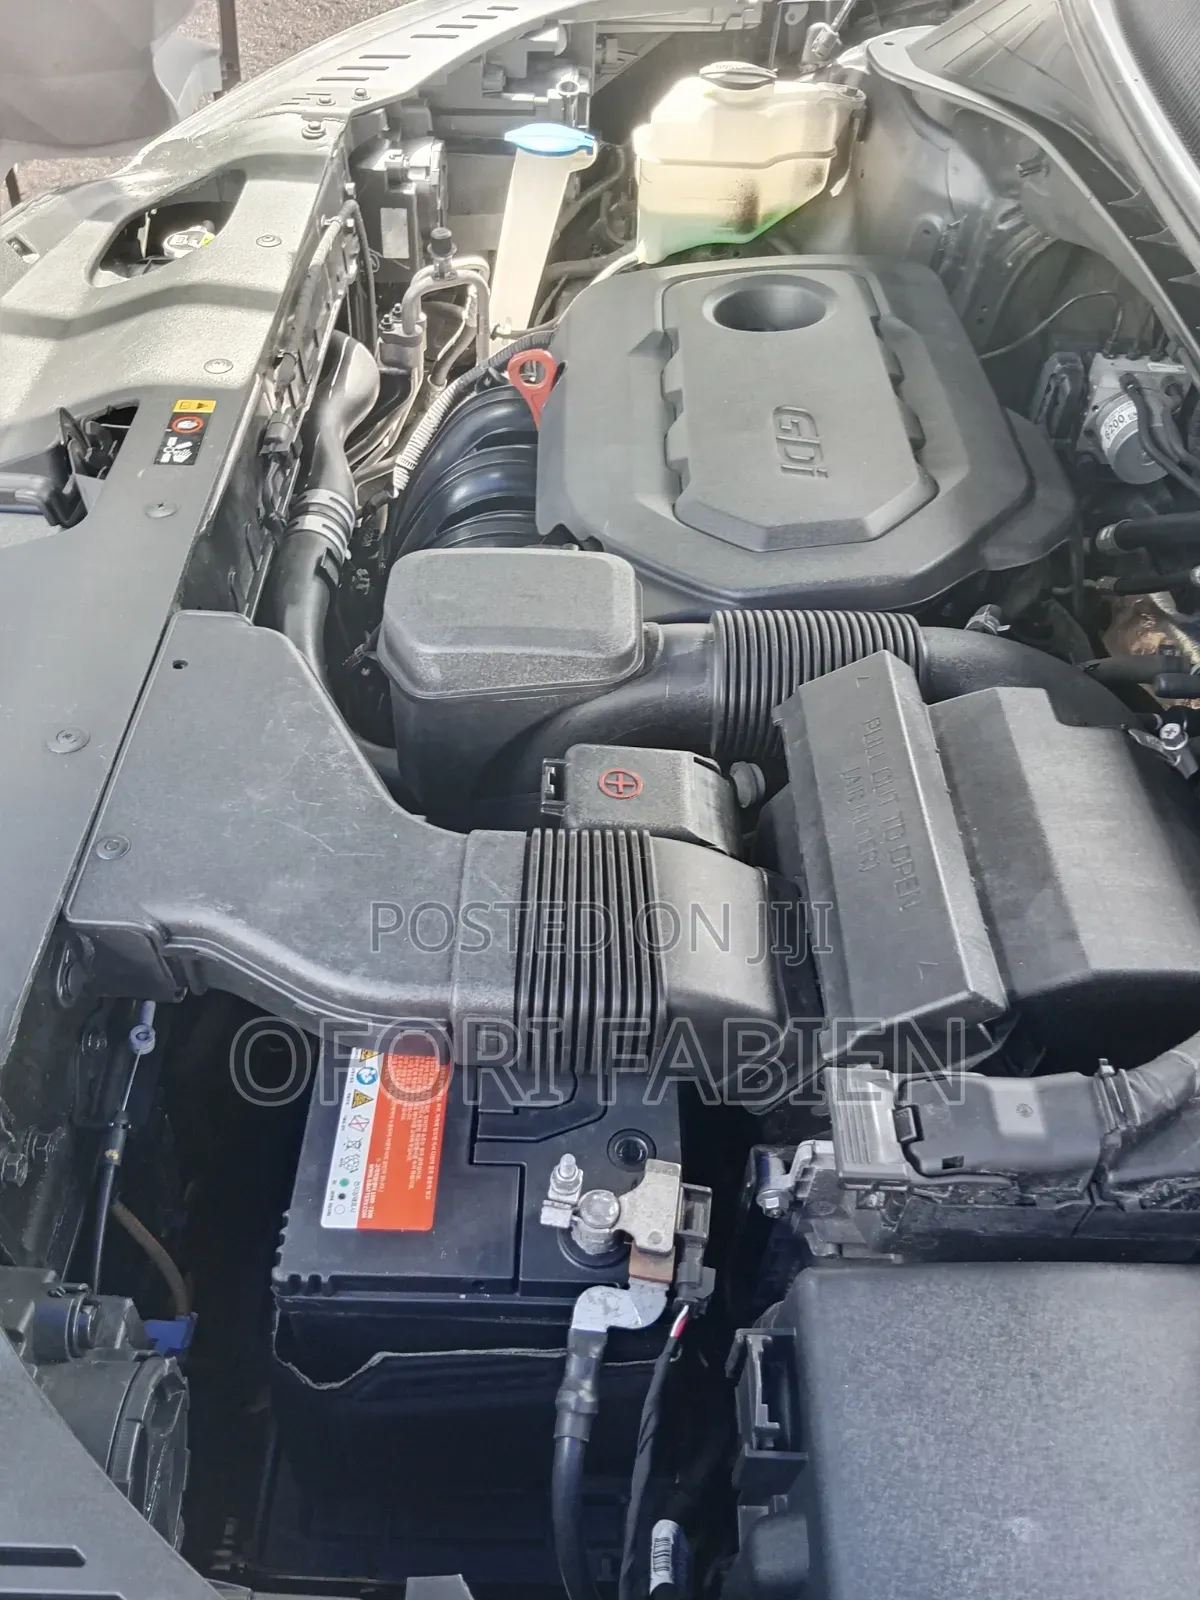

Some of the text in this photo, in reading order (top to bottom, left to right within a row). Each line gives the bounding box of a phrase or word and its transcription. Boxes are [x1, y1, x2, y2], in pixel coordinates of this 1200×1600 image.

[863, 716, 922, 912] PULL OUT TO OPEN
